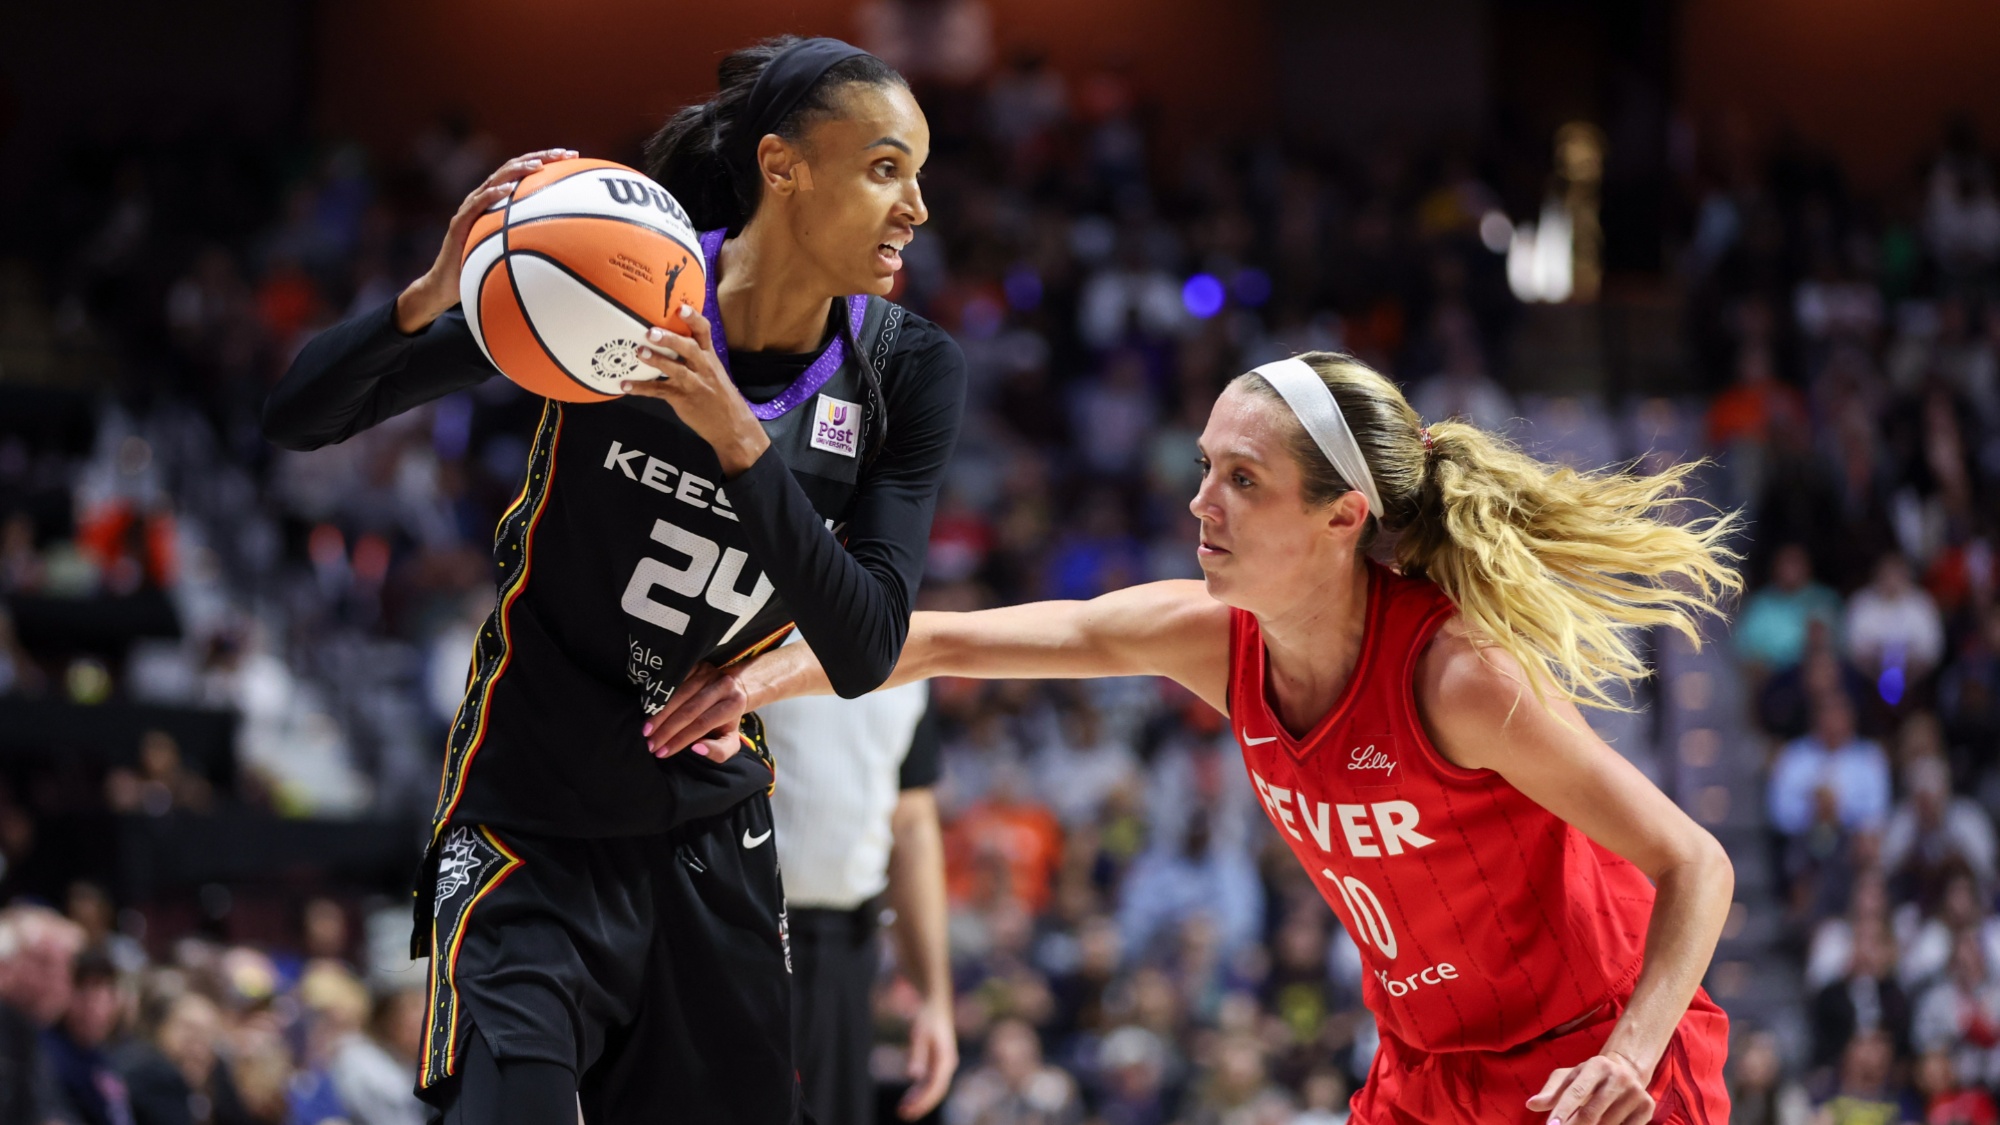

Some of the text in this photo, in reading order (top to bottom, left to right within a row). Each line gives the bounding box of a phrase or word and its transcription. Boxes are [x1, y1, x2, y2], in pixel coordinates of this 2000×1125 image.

[599, 178, 698, 238] Wils
[608, 258, 635, 274] GAME
[634, 269, 654, 285] BALL
[617, 253, 652, 274] OFFICIAL
[818, 421, 853, 444] Post
[621, 518, 776, 647] 24
[628, 633, 663, 670] Yale
[1347, 744, 1397, 777] Lilly
[1251, 768, 1436, 858] FEVER
[1322, 868, 1397, 960] 10
